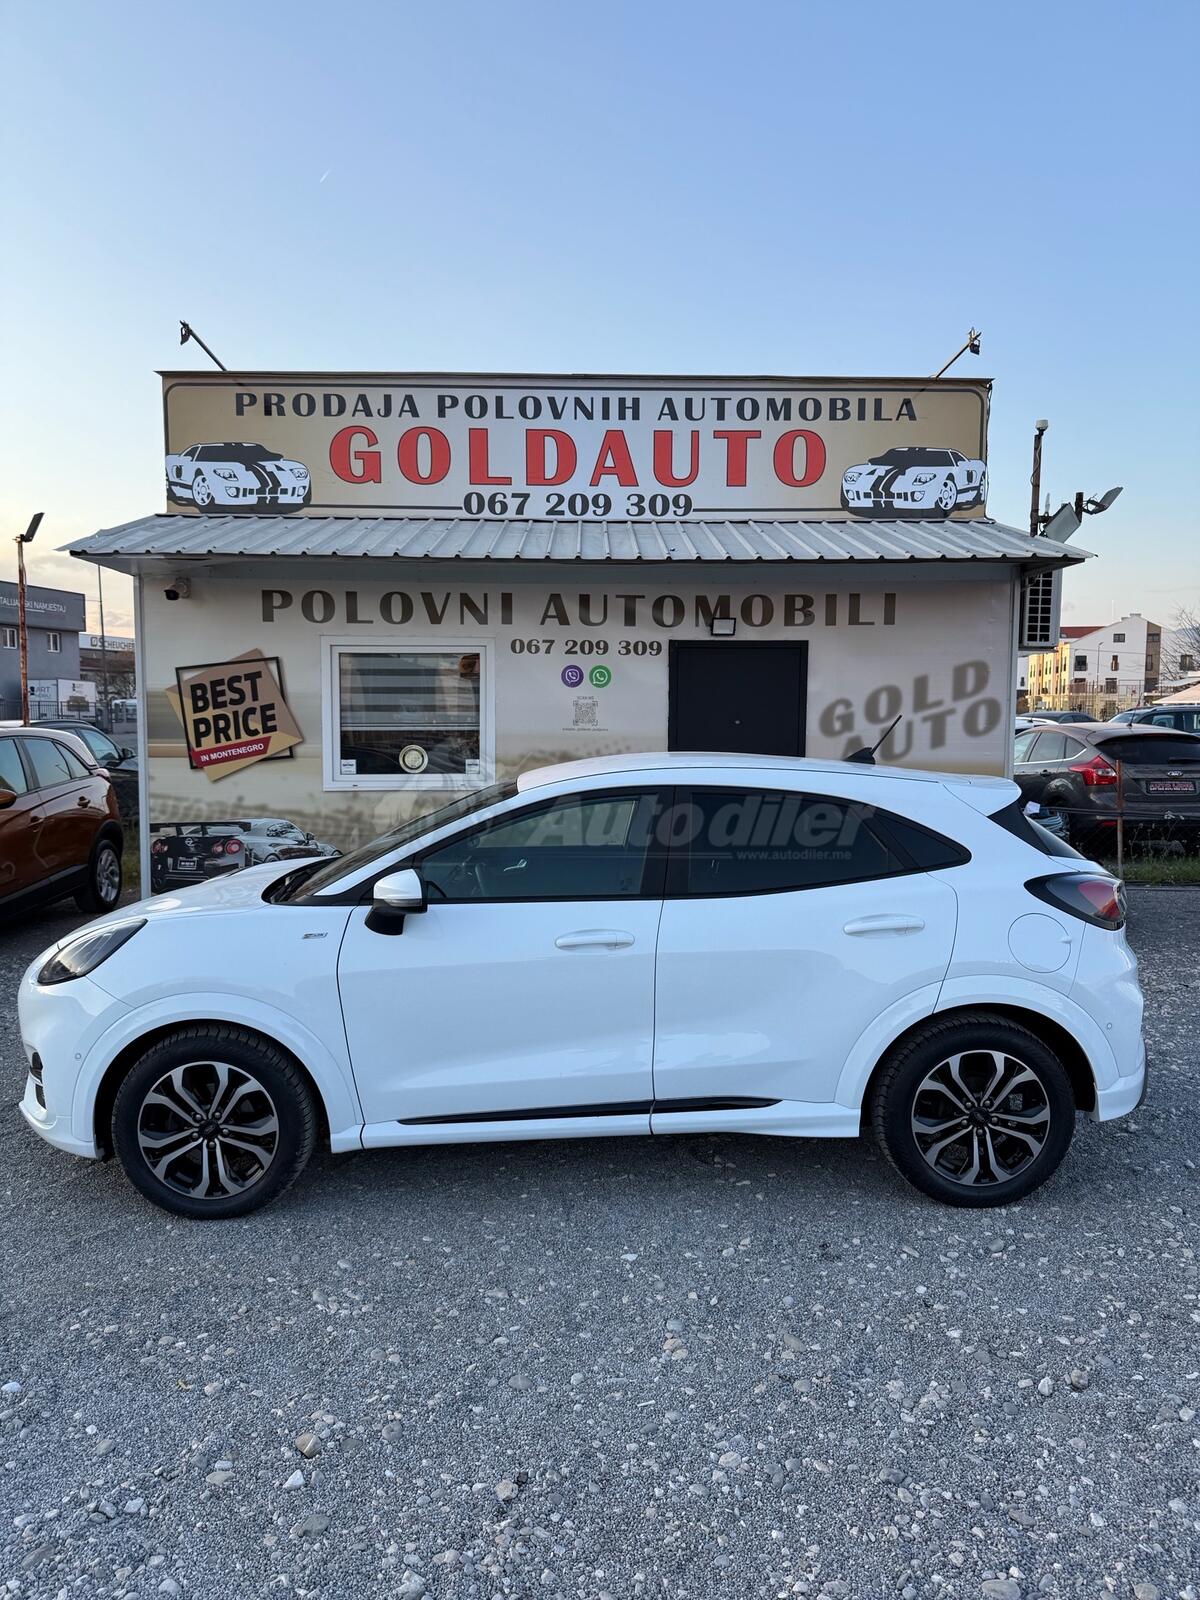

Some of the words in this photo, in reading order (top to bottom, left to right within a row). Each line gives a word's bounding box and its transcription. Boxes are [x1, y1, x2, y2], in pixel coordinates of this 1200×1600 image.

[235, 391, 420, 419] PRODAJA
[436, 394, 641, 421] POLOVNIH
[657, 396, 918, 422] AUTOMOBILA
[329, 425, 827, 487] GOLDAUTO
[462, 491, 531, 516] 067
[545, 492, 612, 517] 209
[625, 493, 694, 517] 309
[261, 589, 513, 625] POLOVNI
[539, 592, 897, 627] AUTOMOBILI
[510, 638, 555, 655] 067
[564, 639, 609, 656] 209
[617, 640, 663, 656] 309
[190, 671, 262, 714] BEST
[819, 659, 991, 738] GOLD
[193, 703, 277, 748] PRICE
[210, 743, 265, 760] MONTENEGRO
